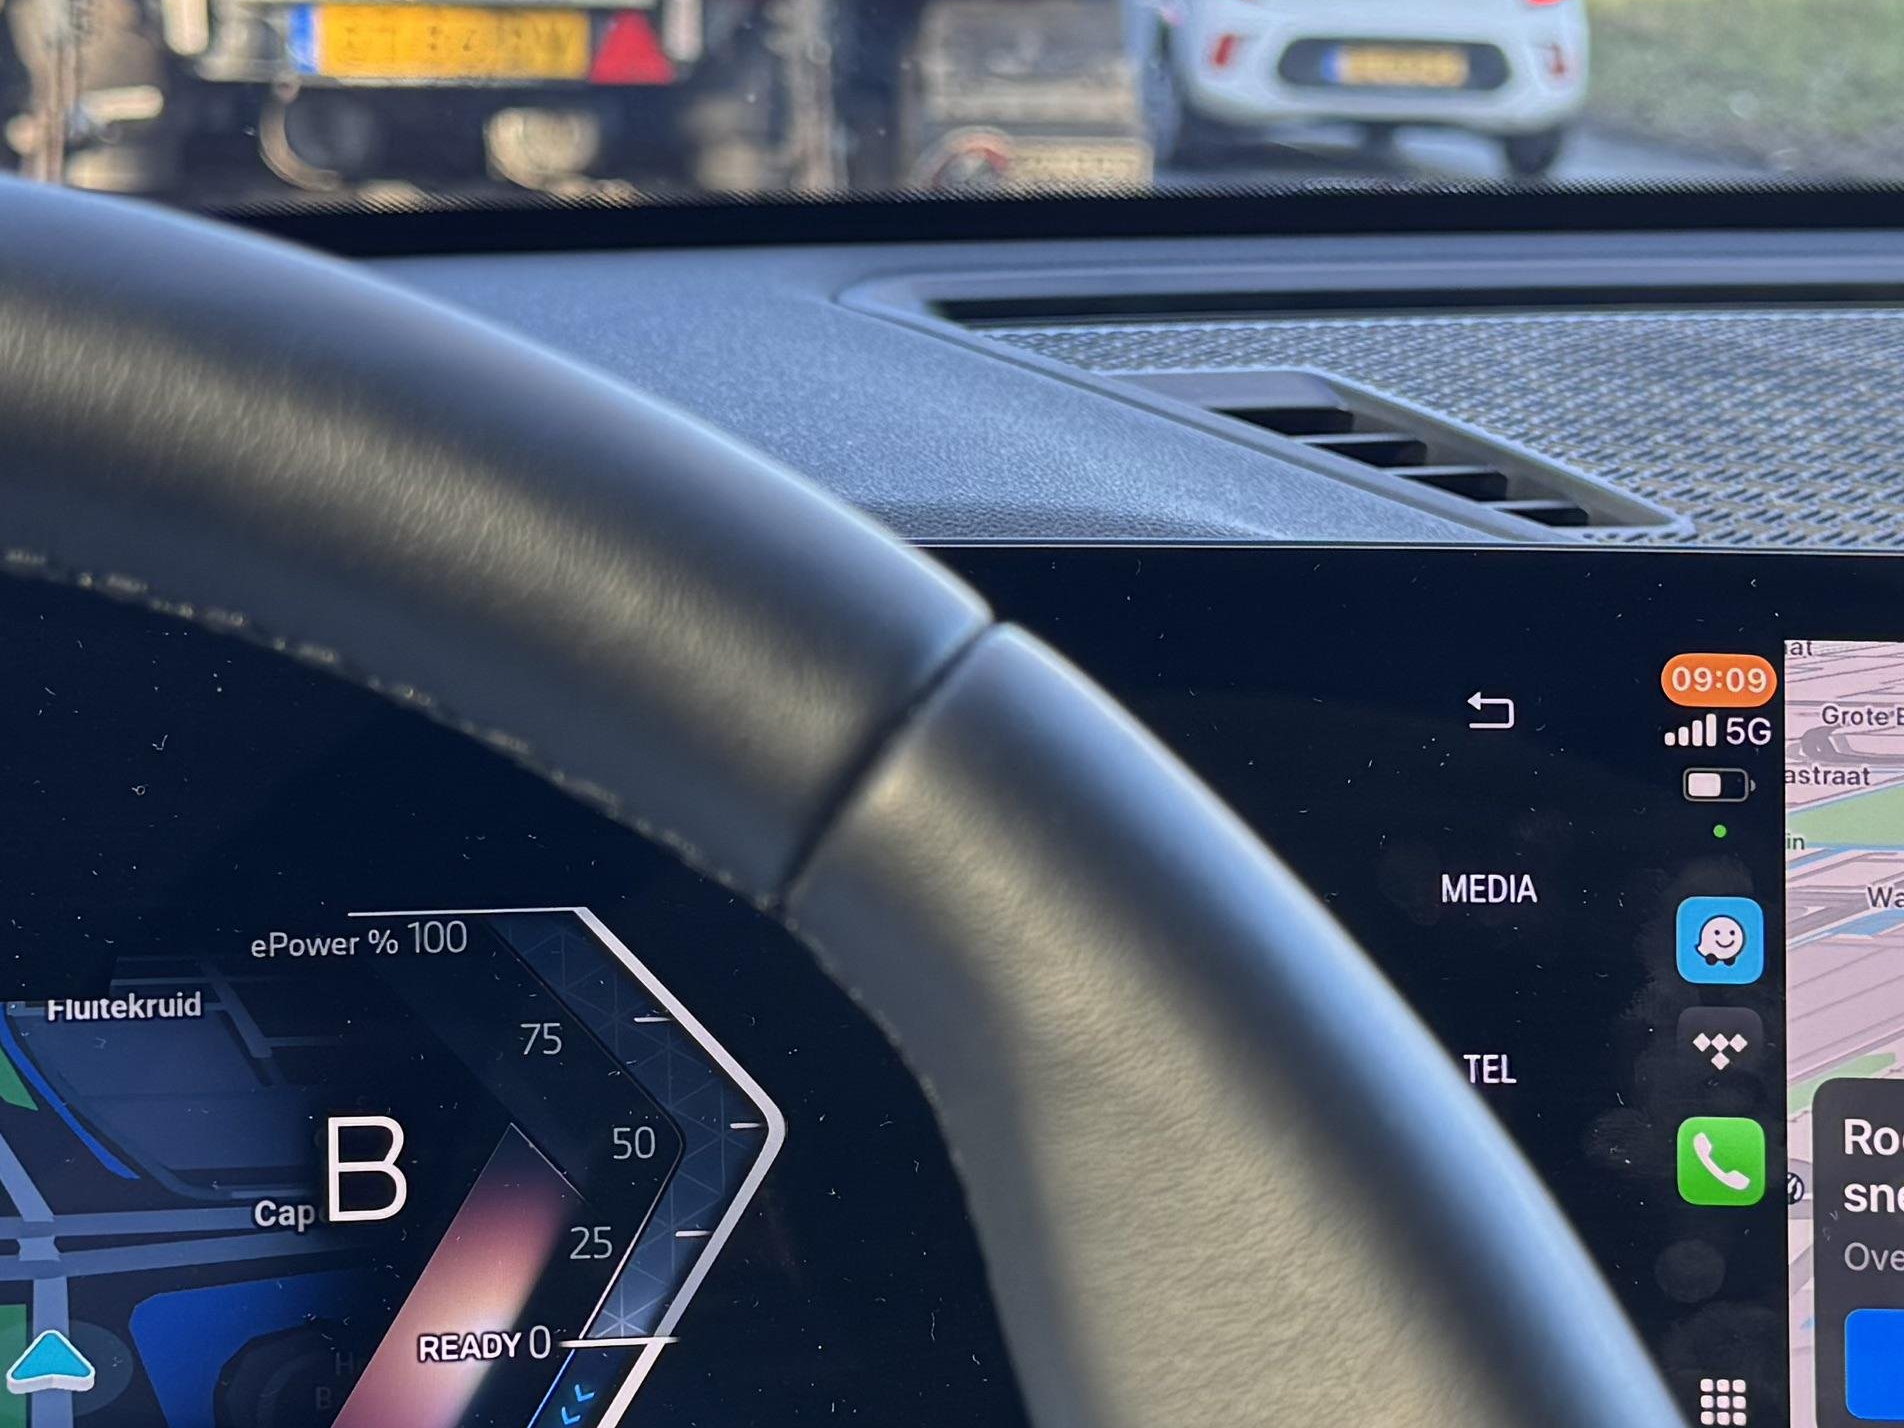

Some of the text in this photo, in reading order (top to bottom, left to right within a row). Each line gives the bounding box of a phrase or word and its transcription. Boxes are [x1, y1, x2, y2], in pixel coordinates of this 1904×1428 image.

[1671, 667, 1767, 692] 09:09
[1726, 718, 1772, 745] 5G
[1822, 707, 1889, 727] Grote
[1442, 874, 1537, 903] MEDIA
[250, 921, 467, 958] ePower % 100
[520, 1023, 563, 1054] 75
[1464, 1054, 1516, 1084] TEL
[612, 1127, 656, 1159] 50
[326, 1115, 407, 1222] B
[570, 1226, 613, 1259] 25
[419, 1326, 551, 1360] READY 0
